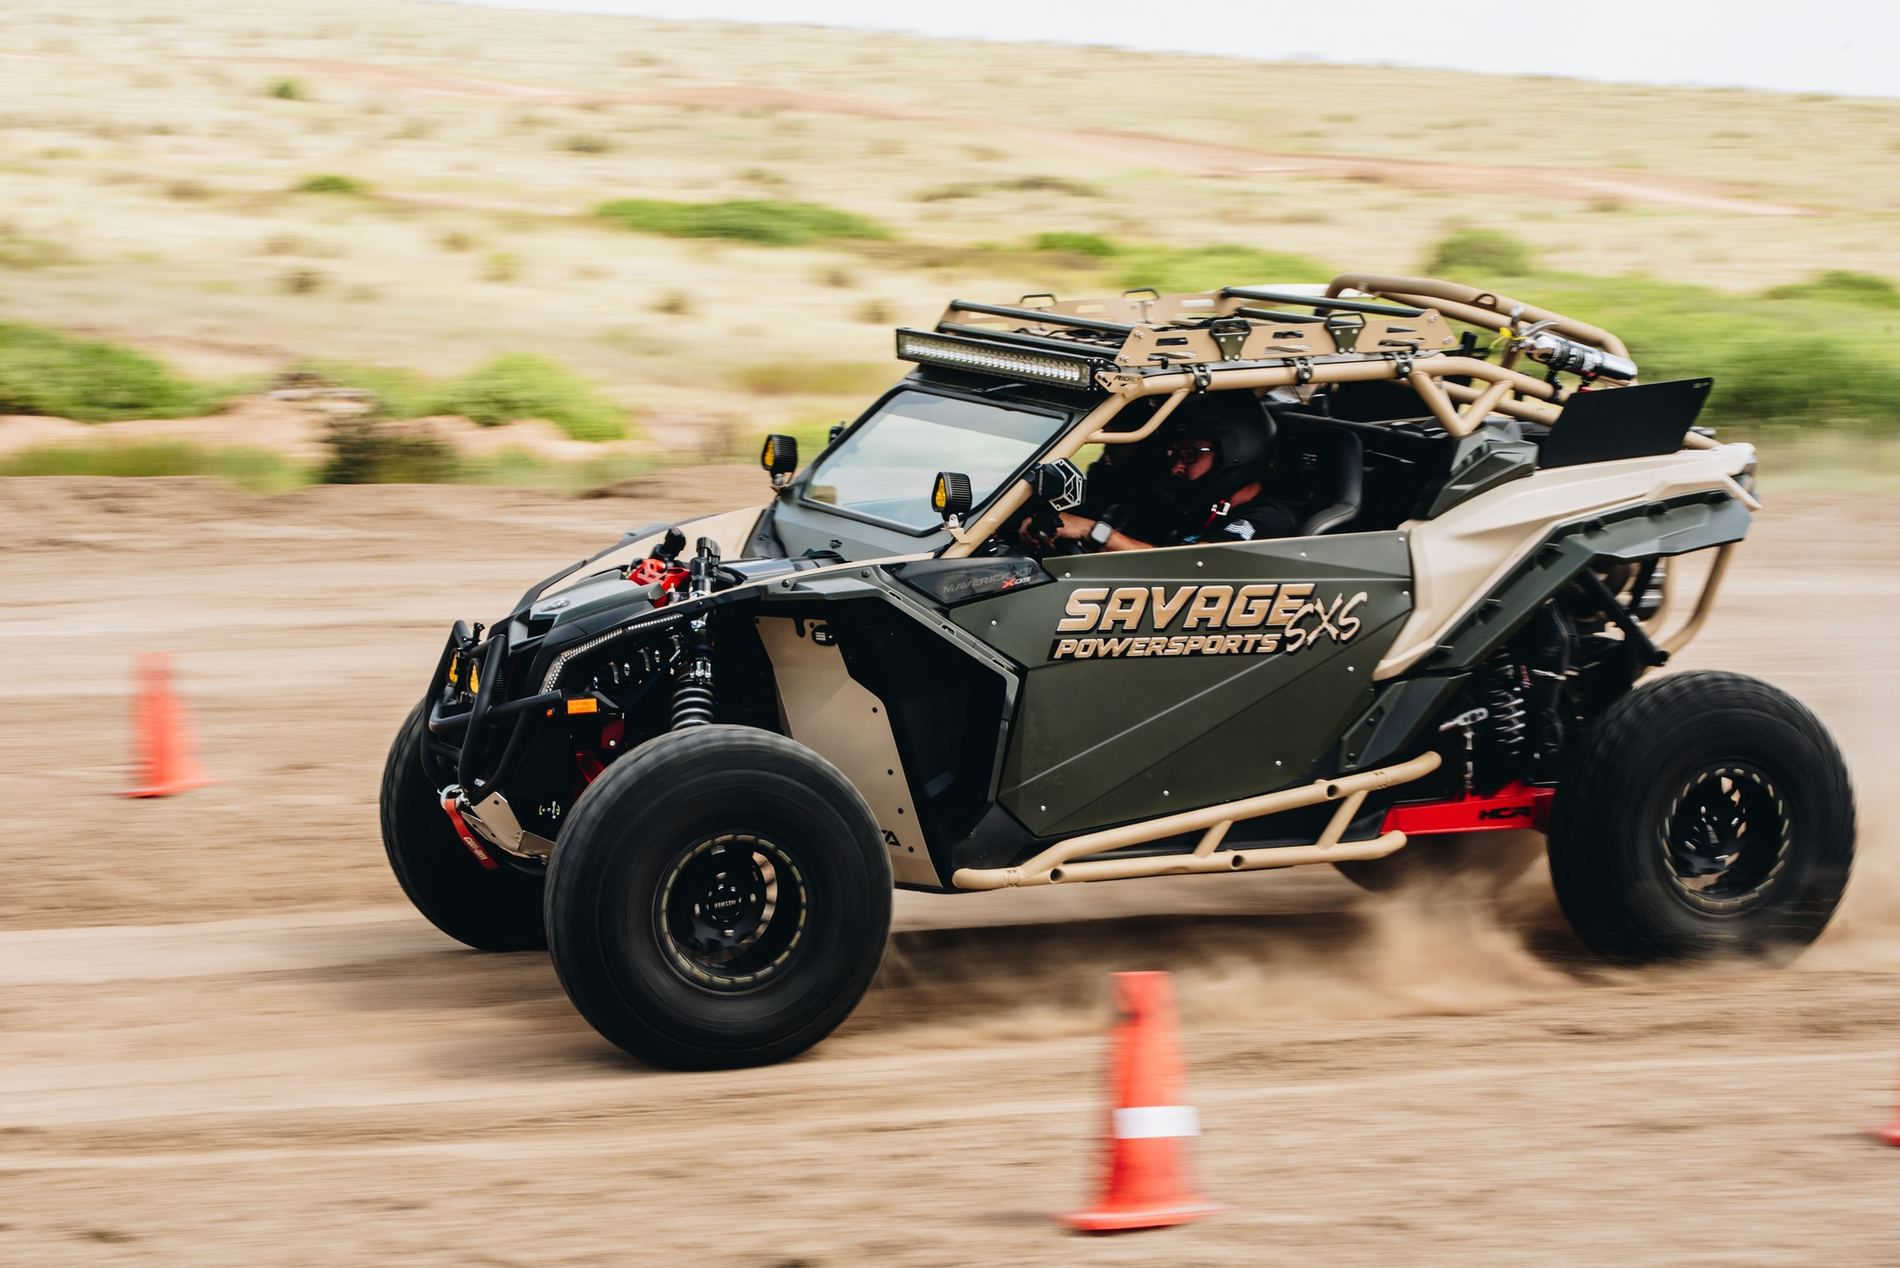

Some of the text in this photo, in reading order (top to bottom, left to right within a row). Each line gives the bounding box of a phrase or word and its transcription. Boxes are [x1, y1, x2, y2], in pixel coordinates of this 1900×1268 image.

[944, 572, 1011, 593] MAVERICK
[1056, 583, 1315, 631] SAVAGE
[1284, 591, 1368, 652] SXS
[1053, 633, 1282, 659] POWERSPORTS
